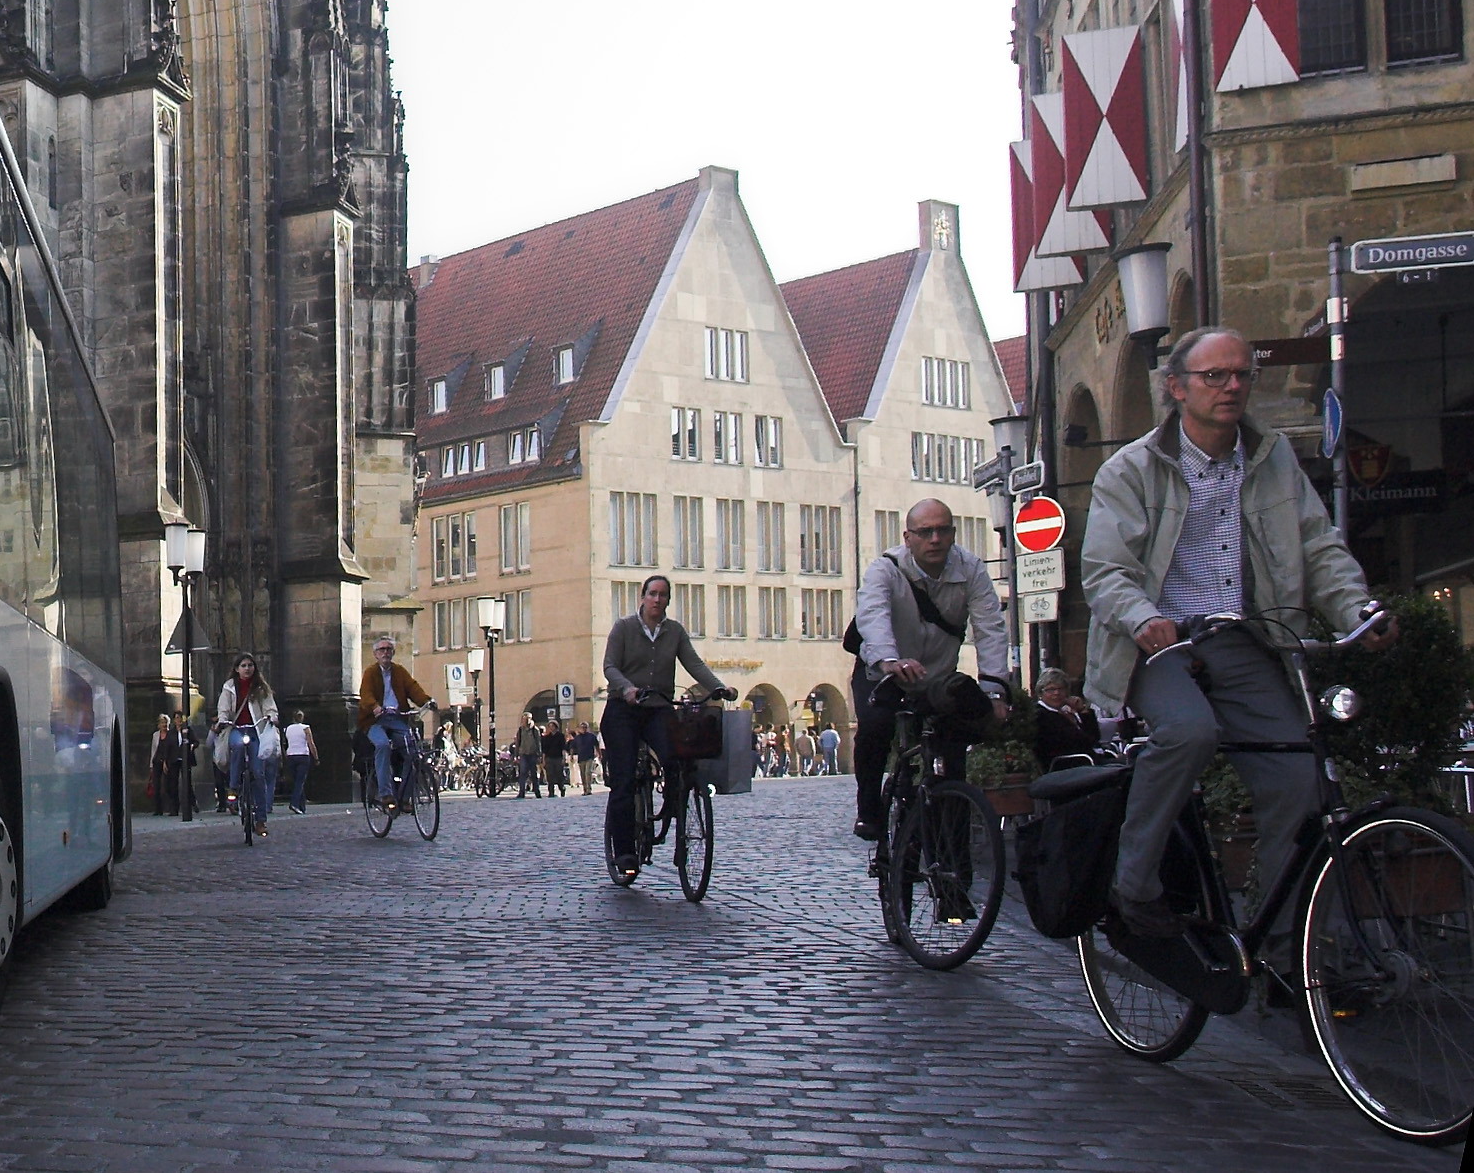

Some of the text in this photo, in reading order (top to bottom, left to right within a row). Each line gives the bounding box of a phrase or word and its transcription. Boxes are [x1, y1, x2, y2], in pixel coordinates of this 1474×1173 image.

[1368, 243, 1468, 264] Domgasse
[1349, 485, 1438, 502] Kleimann
[1023, 557, 1054, 568] Linien-
[1022, 566, 1056, 579] verkehr
[1032, 578, 1048, 588] frei
